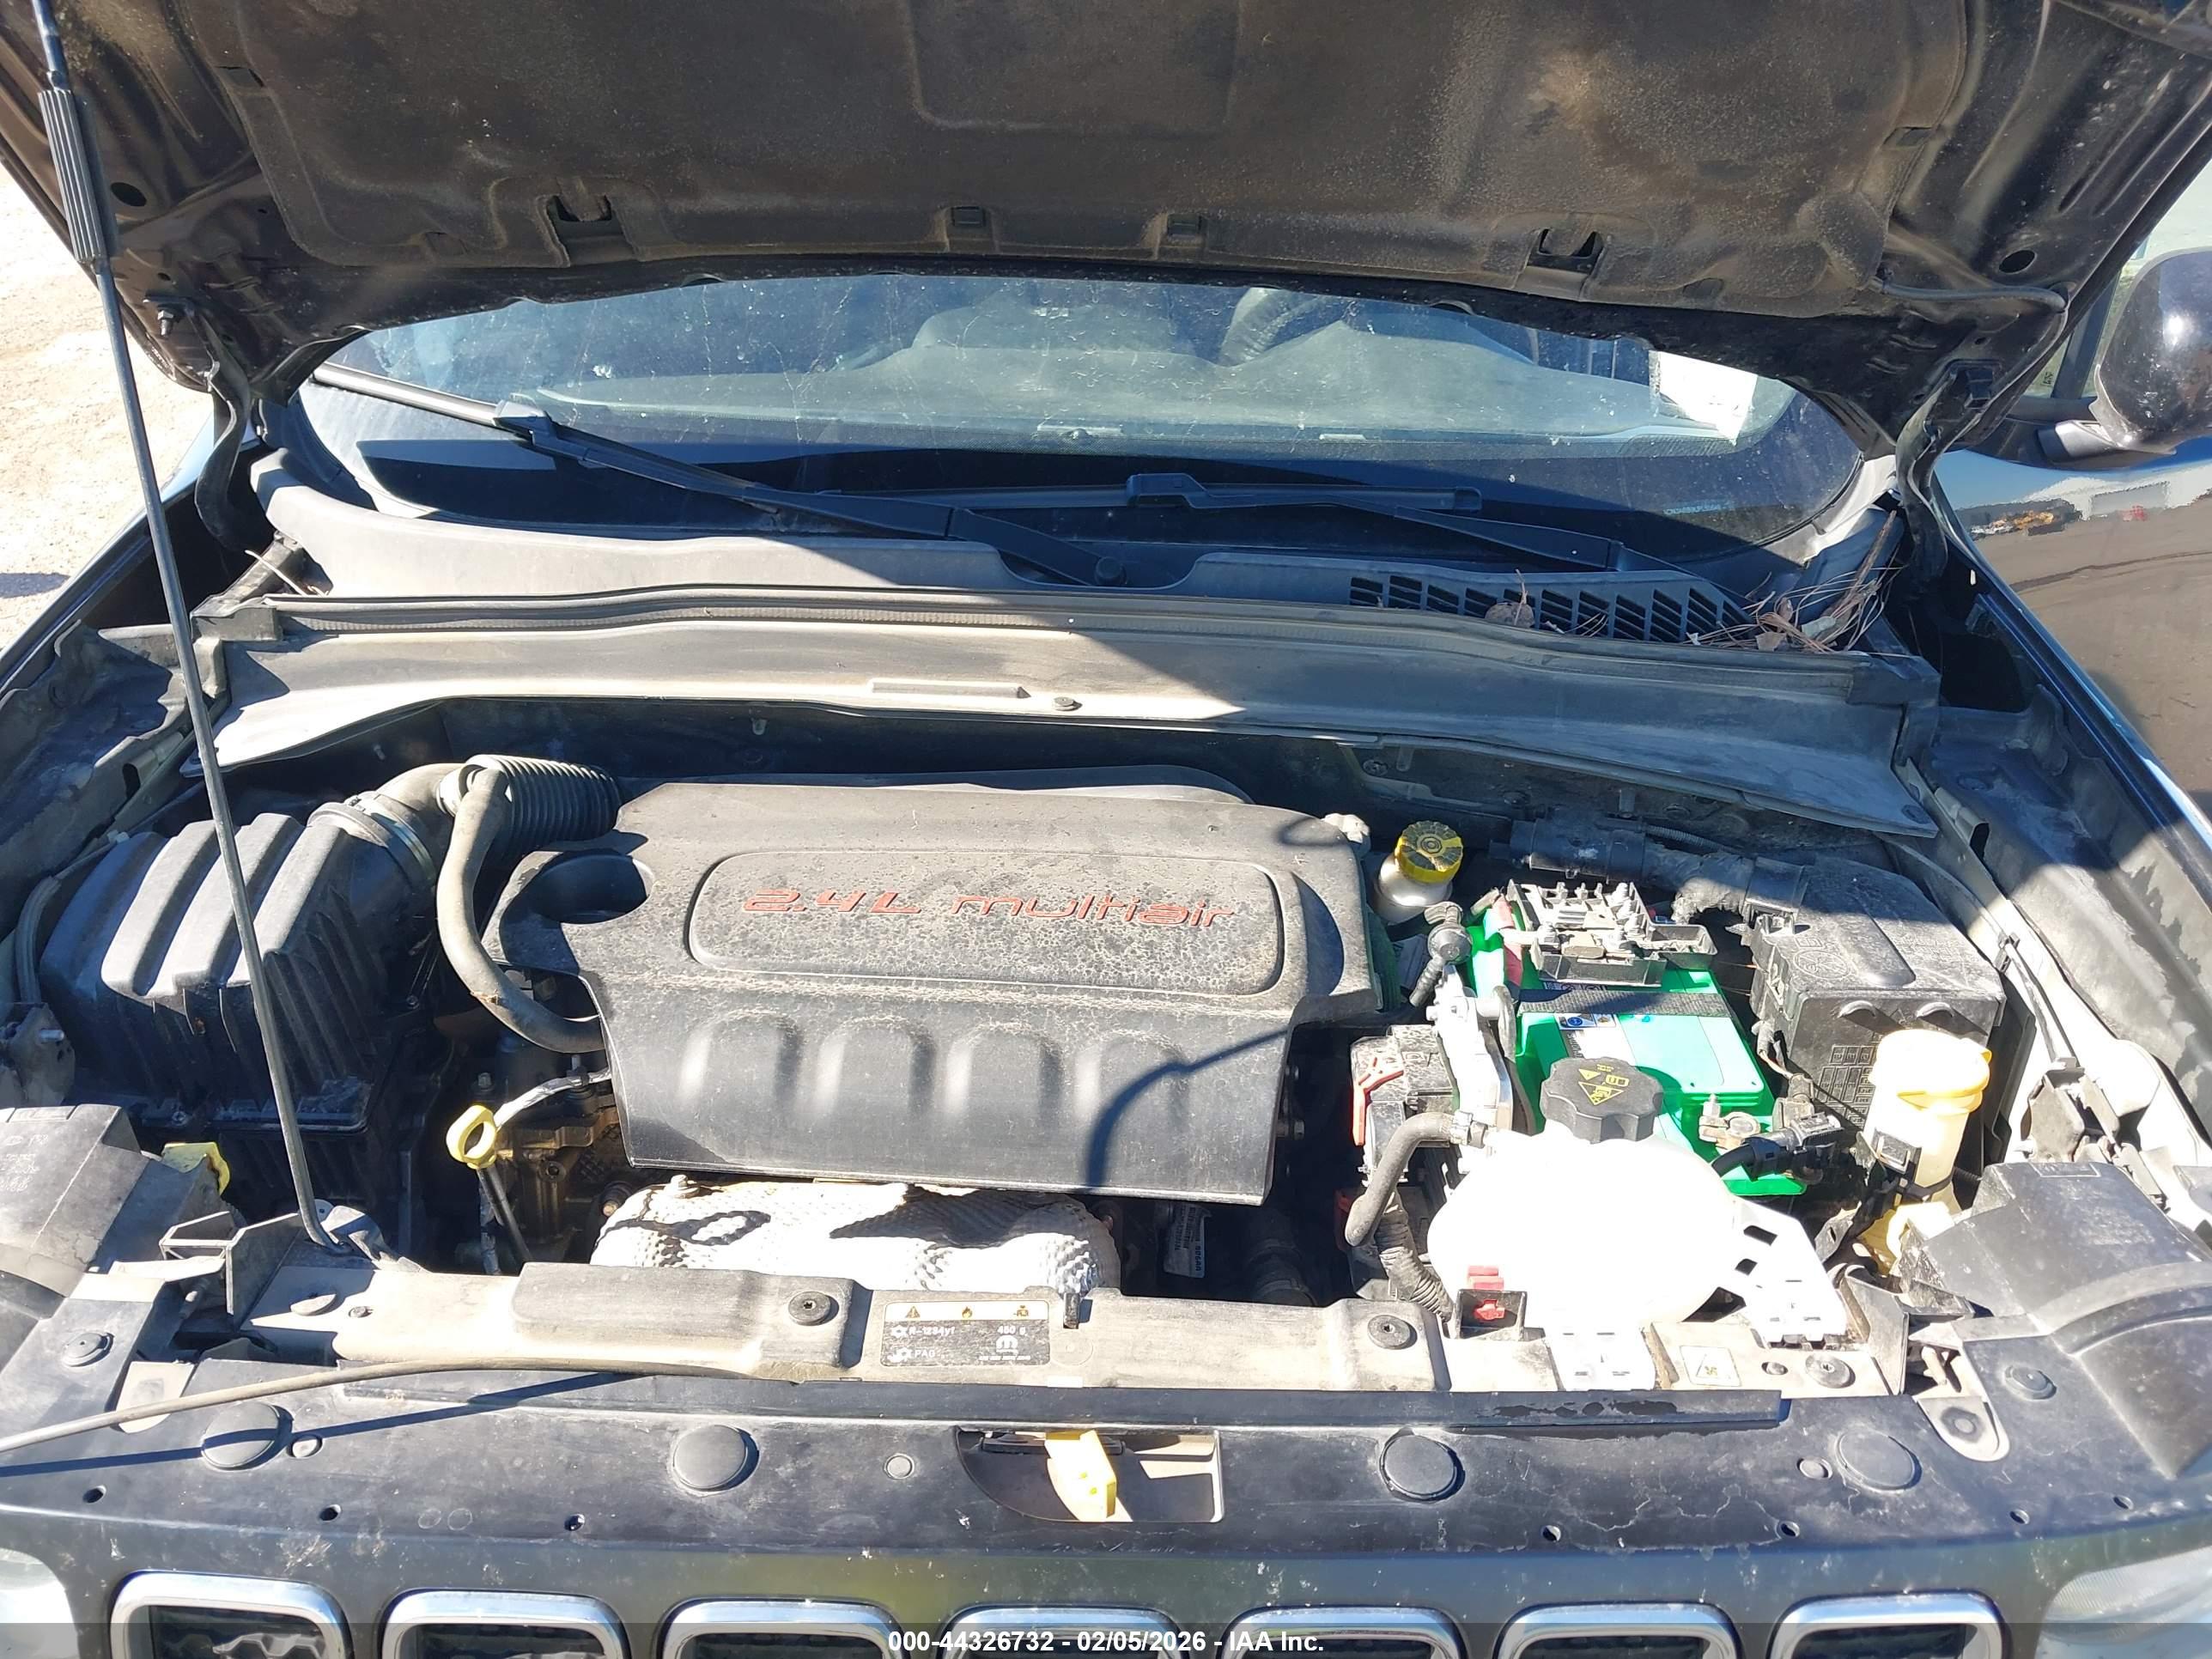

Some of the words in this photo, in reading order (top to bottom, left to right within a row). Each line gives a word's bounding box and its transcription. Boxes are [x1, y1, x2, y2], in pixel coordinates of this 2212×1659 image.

[743, 887, 921, 915] 2.4L
[951, 894, 1235, 927] multiair
[914, 1349, 936, 1358] PAG
